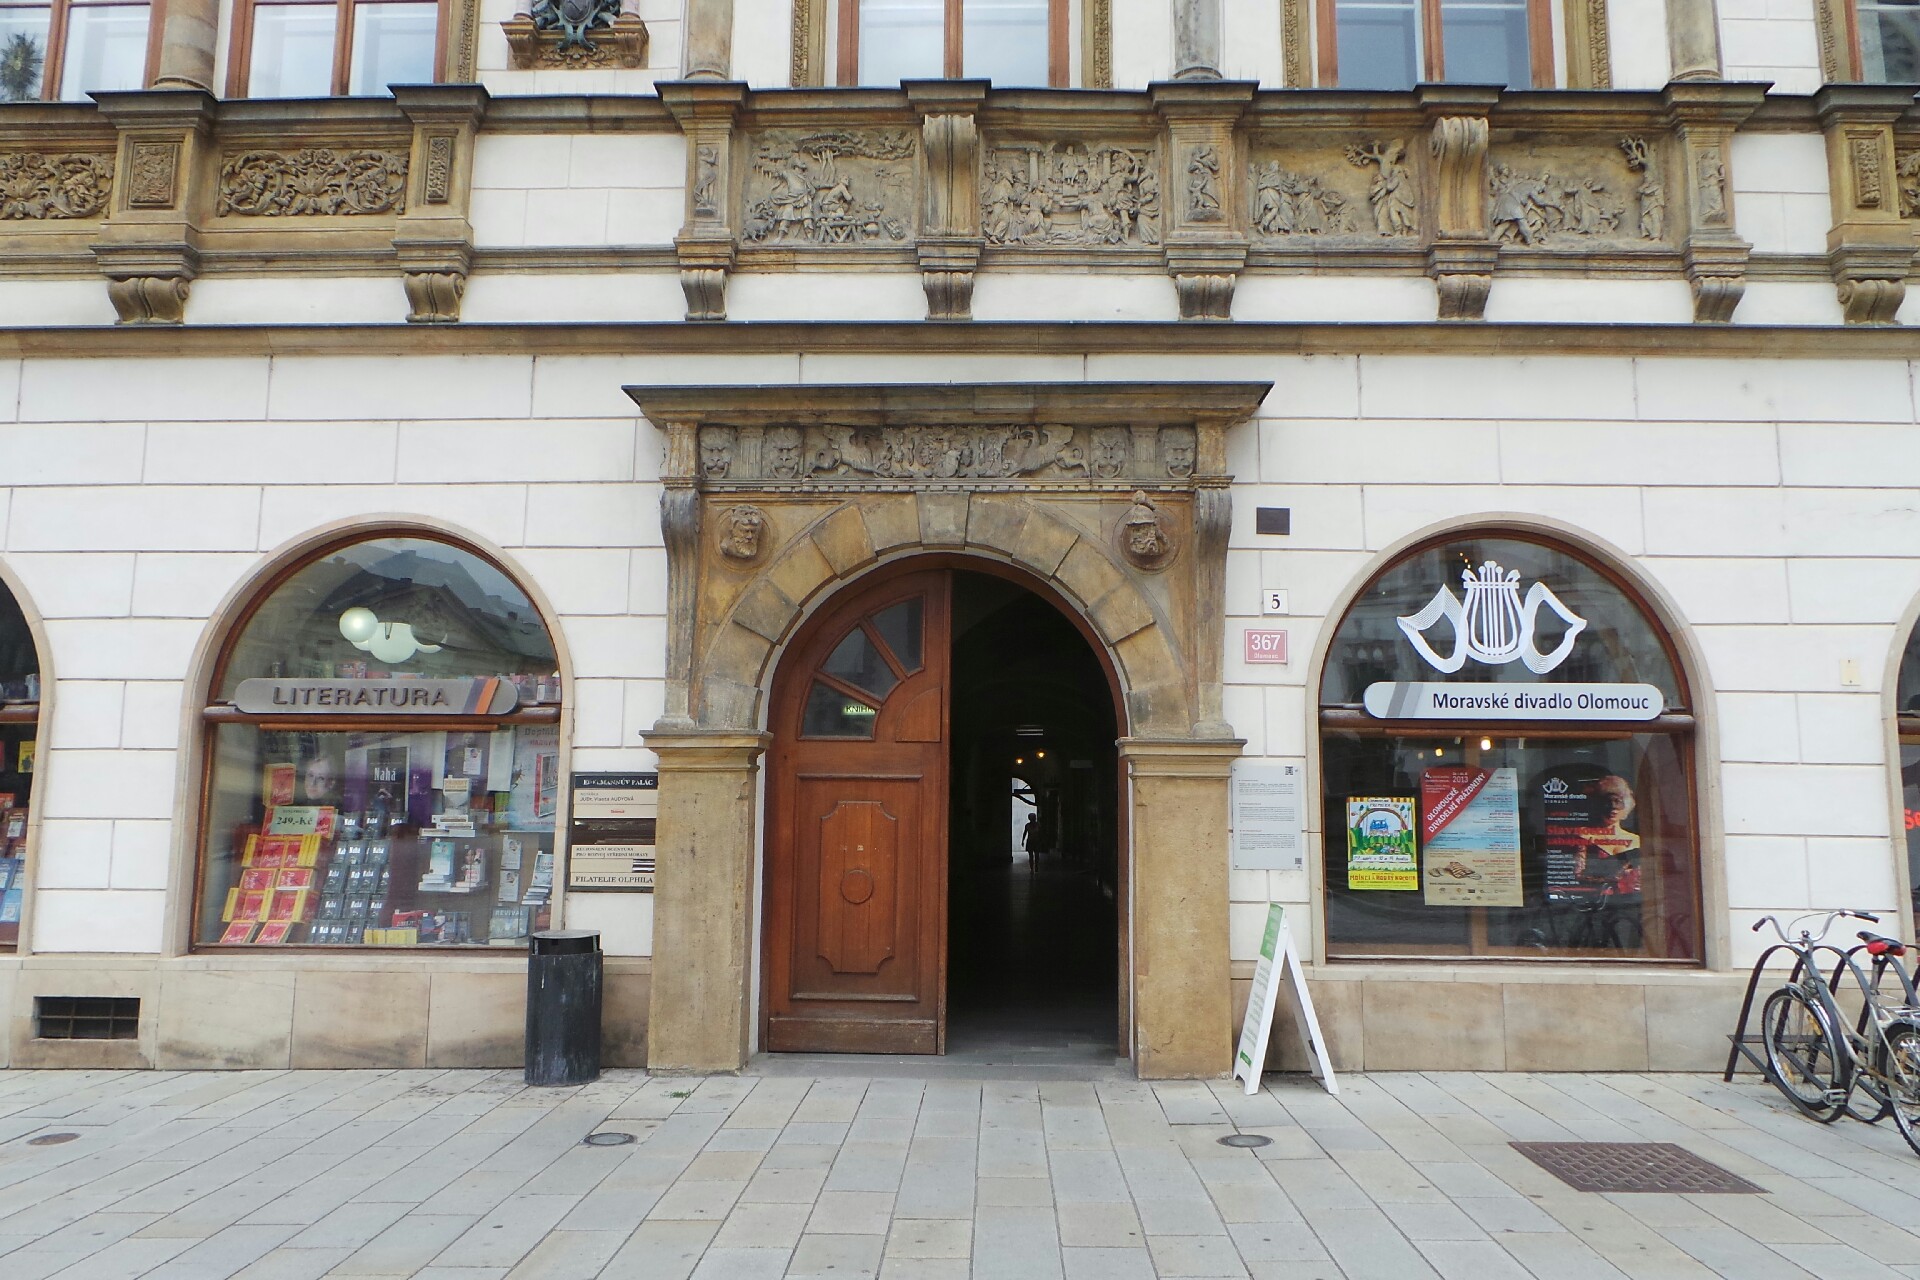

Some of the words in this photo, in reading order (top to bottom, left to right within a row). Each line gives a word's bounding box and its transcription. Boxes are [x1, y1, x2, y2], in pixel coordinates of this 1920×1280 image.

[1271, 594, 1280, 609] 5
[1251, 634, 1280, 651] 367
[272, 686, 449, 706] LITERATURA
[1432, 692, 1509, 709] Moravské
[1514, 692, 1572, 709] divadlo
[1577, 693, 1649, 710] Olomouc
[374, 767, 396, 781] Nahá
[631, 778, 654, 786] PALÁC
[1427, 787, 1459, 820] OLOMOUCKÉ
[1428, 801, 1458, 832] DIVADELNÍ
[1455, 772, 1486, 805] PRÁZDNINY
